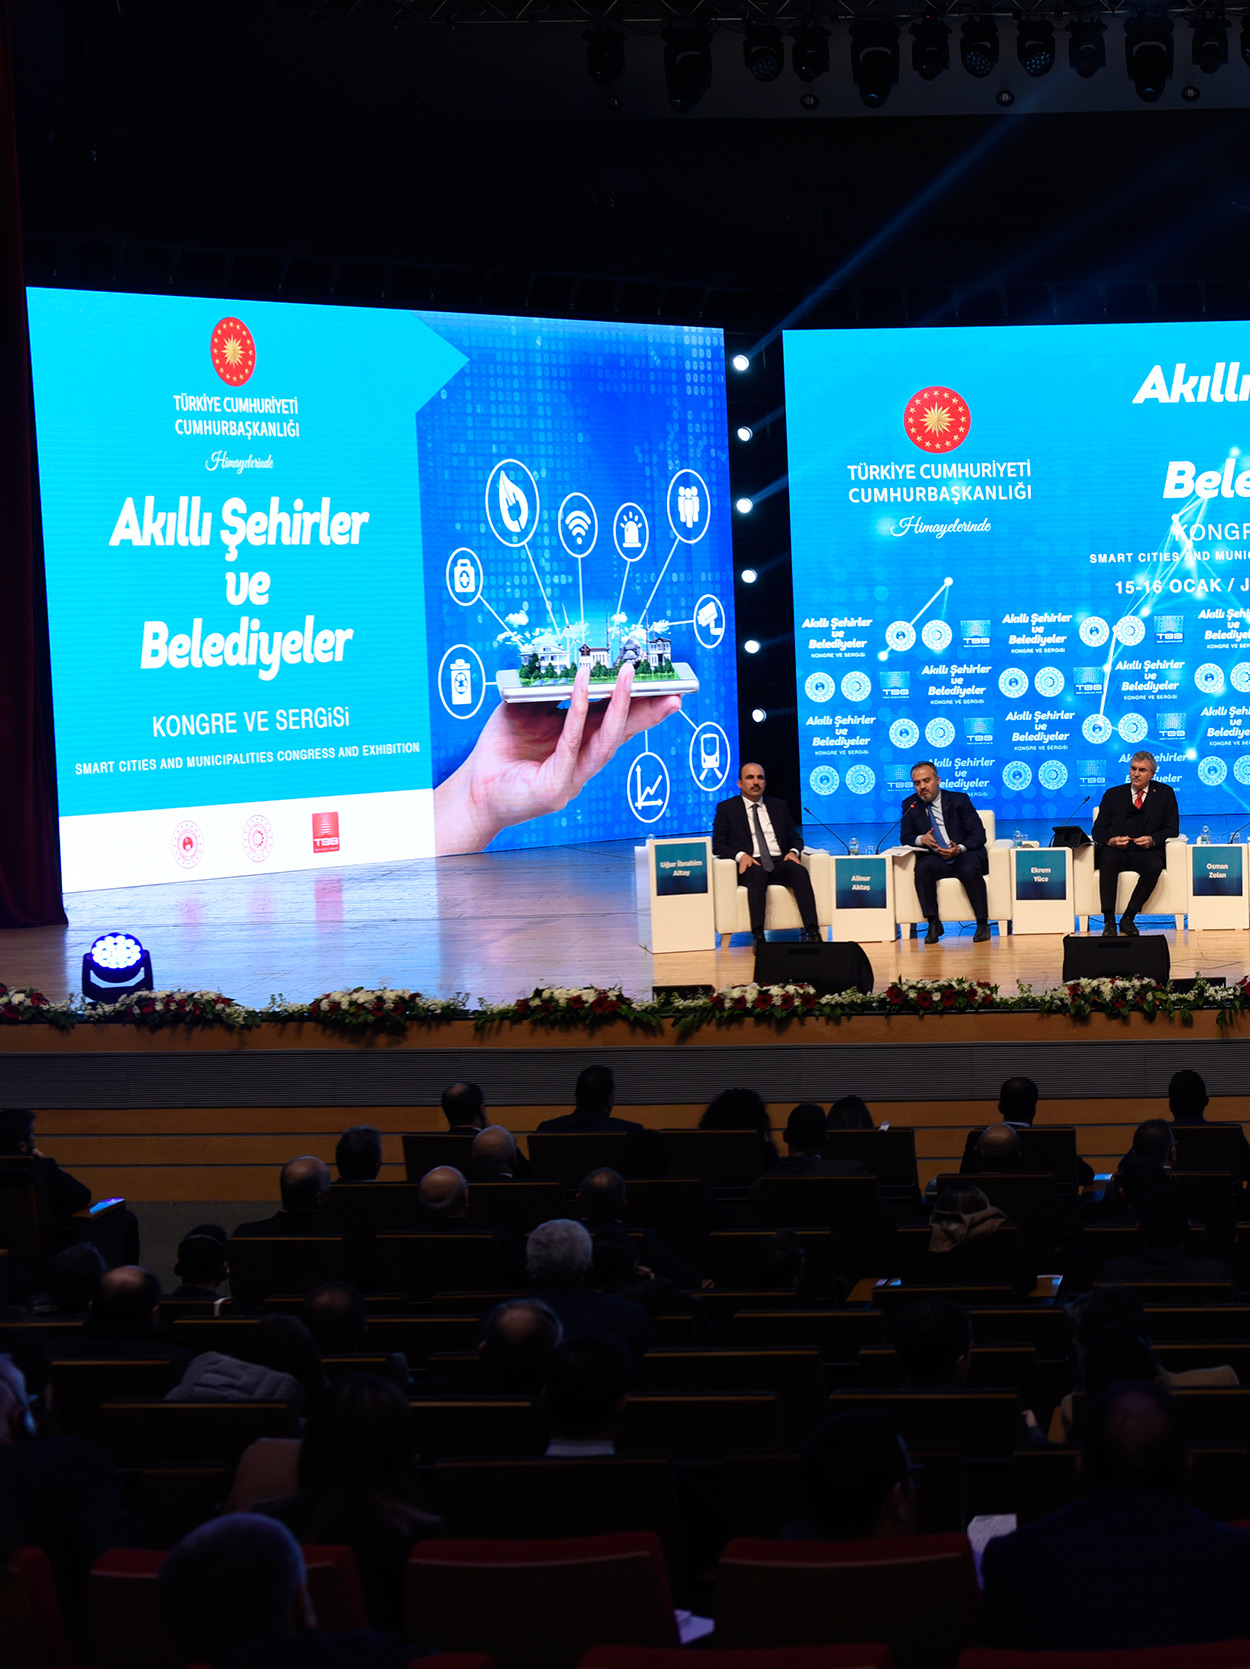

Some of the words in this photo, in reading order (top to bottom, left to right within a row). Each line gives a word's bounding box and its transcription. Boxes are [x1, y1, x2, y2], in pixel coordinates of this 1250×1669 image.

[173, 393, 221, 412] TÜRKİYE
[224, 396, 298, 414] CUMHURİYETİ
[175, 419, 299, 440] CUMHURBAŞKANLIĞI
[206, 450, 273, 474] Himayelerinde
[847, 462, 916, 480] TÜRKİYE
[920, 459, 1030, 479] CUMHURİYETİ
[849, 482, 1031, 504] CUMHURBAŞKANLIĞI
[109, 496, 212, 546] Akıllı
[220, 497, 370, 562] Şehirler
[890, 516, 991, 538] Himayelerinde
[1090, 553, 1133, 563] SMART
[1138, 552, 1179, 562] CITIES
[1185, 552, 1210, 560] AND
[226, 572, 270, 605] ve
[1116, 580, 1162, 594] 15-16
[1170, 578, 1221, 593] OCAK
[1227, 578, 1234, 592] /
[830, 617, 872, 630] Şehirler
[1030, 612, 1072, 625] Şehirler
[808, 638, 866, 651] Belediyeler
[1008, 634, 1066, 646] Belediyeler
[141, 615, 354, 681] Belediyeler
[949, 664, 991, 676] Şehirler
[1143, 659, 1185, 672] Şehirler
[928, 685, 986, 698] Belediyeler
[1122, 681, 1180, 693] Belediyeler
[834, 715, 875, 727] Şehirler
[1034, 710, 1075, 723] Şehirler
[153, 712, 237, 737] KONGRE
[244, 711, 269, 731] VE
[812, 736, 870, 748] Belediyeler
[1012, 732, 1070, 744] Belediyeler
[75, 761, 114, 775] SMART
[119, 759, 156, 772] CITIES
[160, 757, 183, 769] AND
[187, 752, 273, 767] MUNICIPALITIES
[277, 748, 335, 761] CONGRESS
[338, 746, 359, 757] AND
[363, 743, 419, 756] EXHIBITION
[313, 837, 339, 848] TBB
